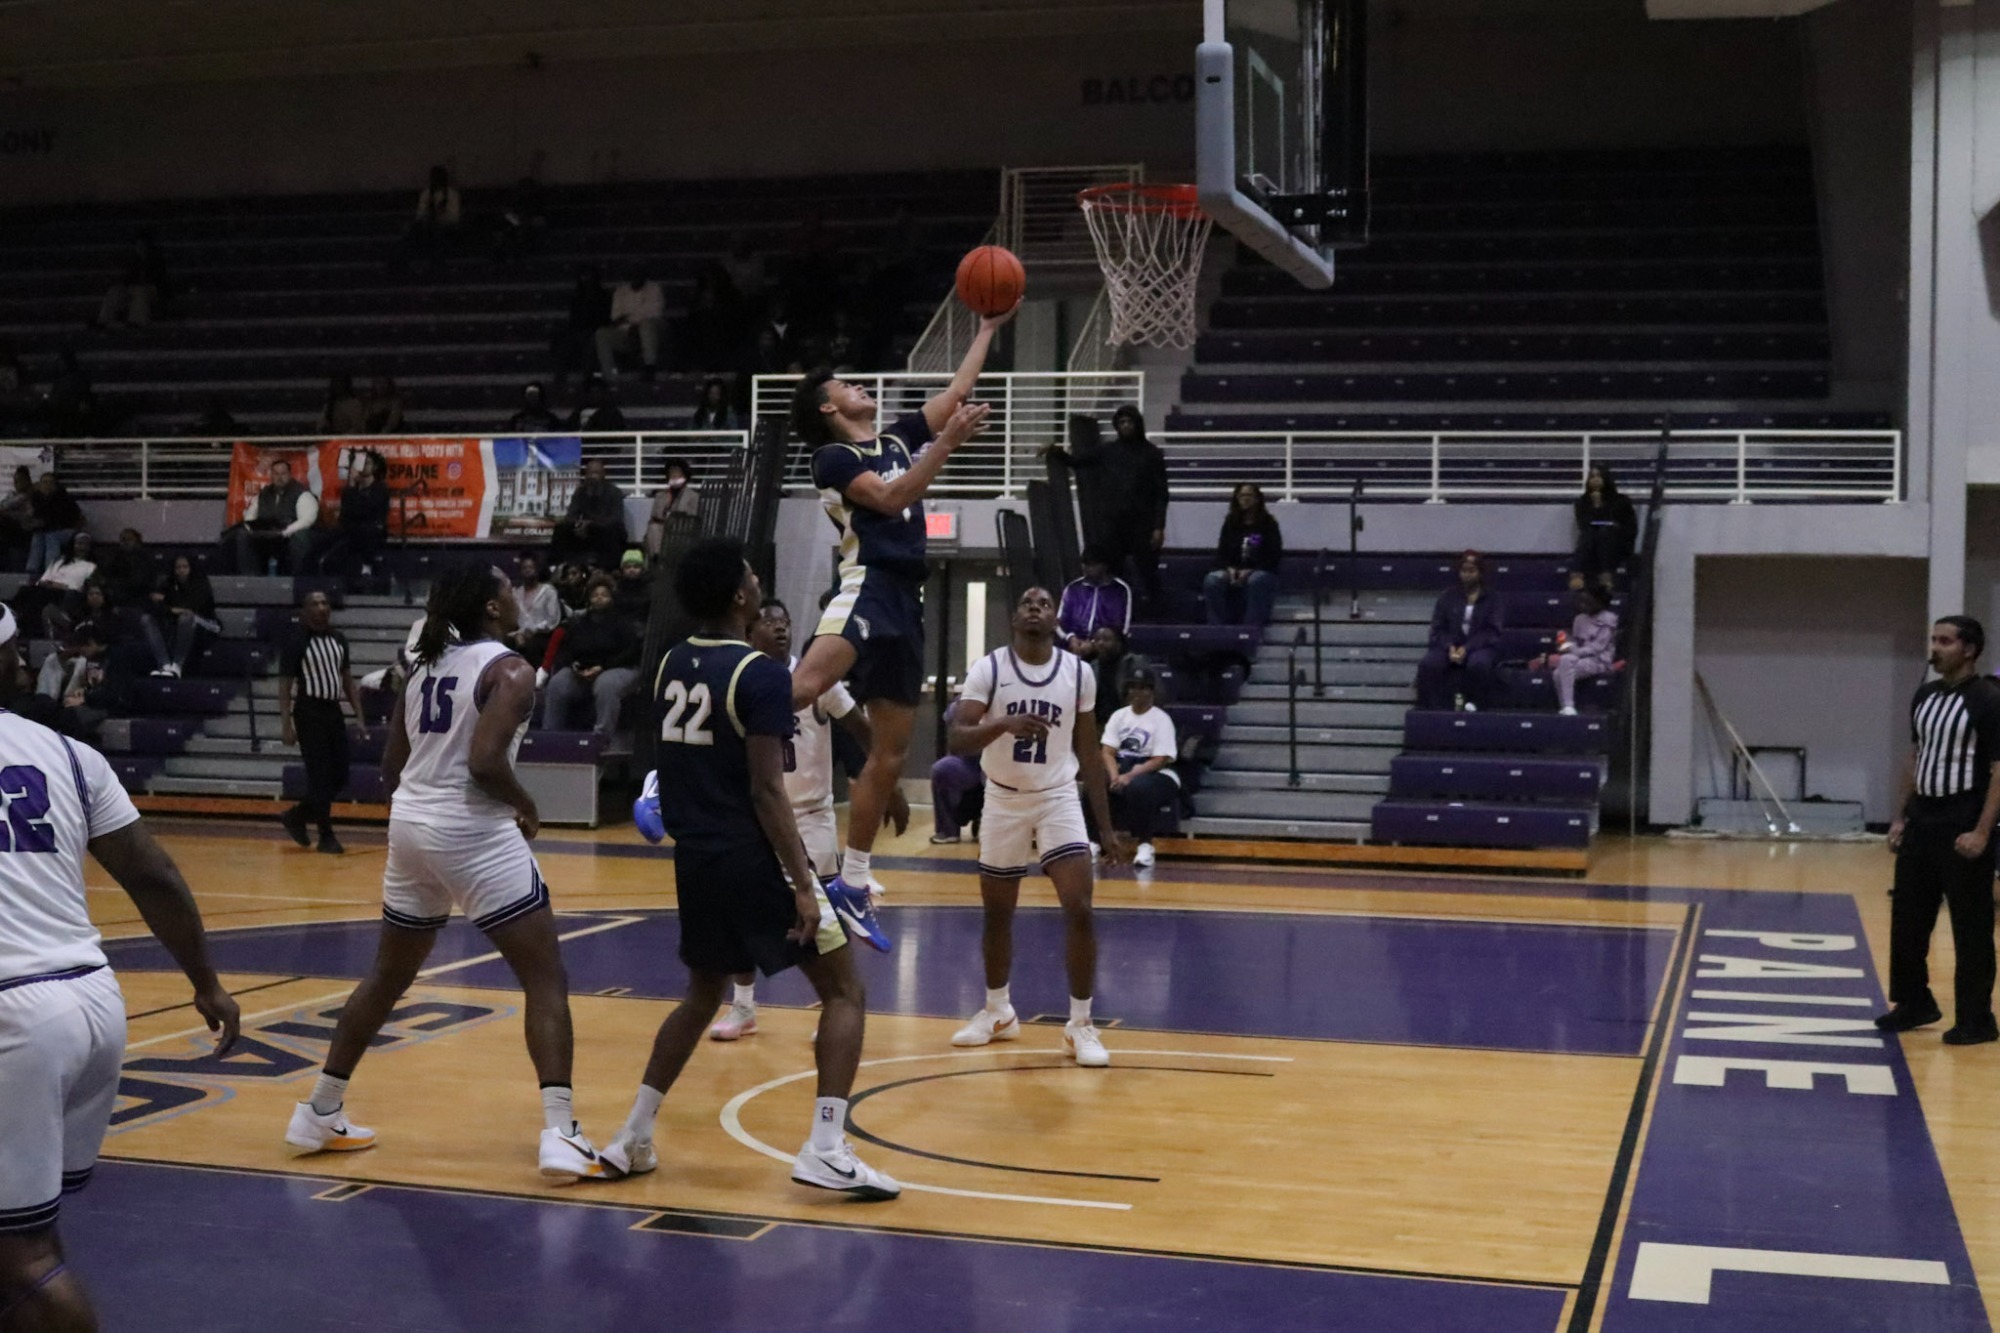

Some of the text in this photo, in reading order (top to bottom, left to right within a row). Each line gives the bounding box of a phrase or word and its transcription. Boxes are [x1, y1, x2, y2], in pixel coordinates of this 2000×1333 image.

[386, 464, 438, 479] SPAINE
[419, 677, 458, 733] 15
[661, 679, 714, 746] 22
[1013, 734, 1047, 764] 21
[0, 765, 58, 853] 2
[1673, 929, 1898, 1096] PAINE
